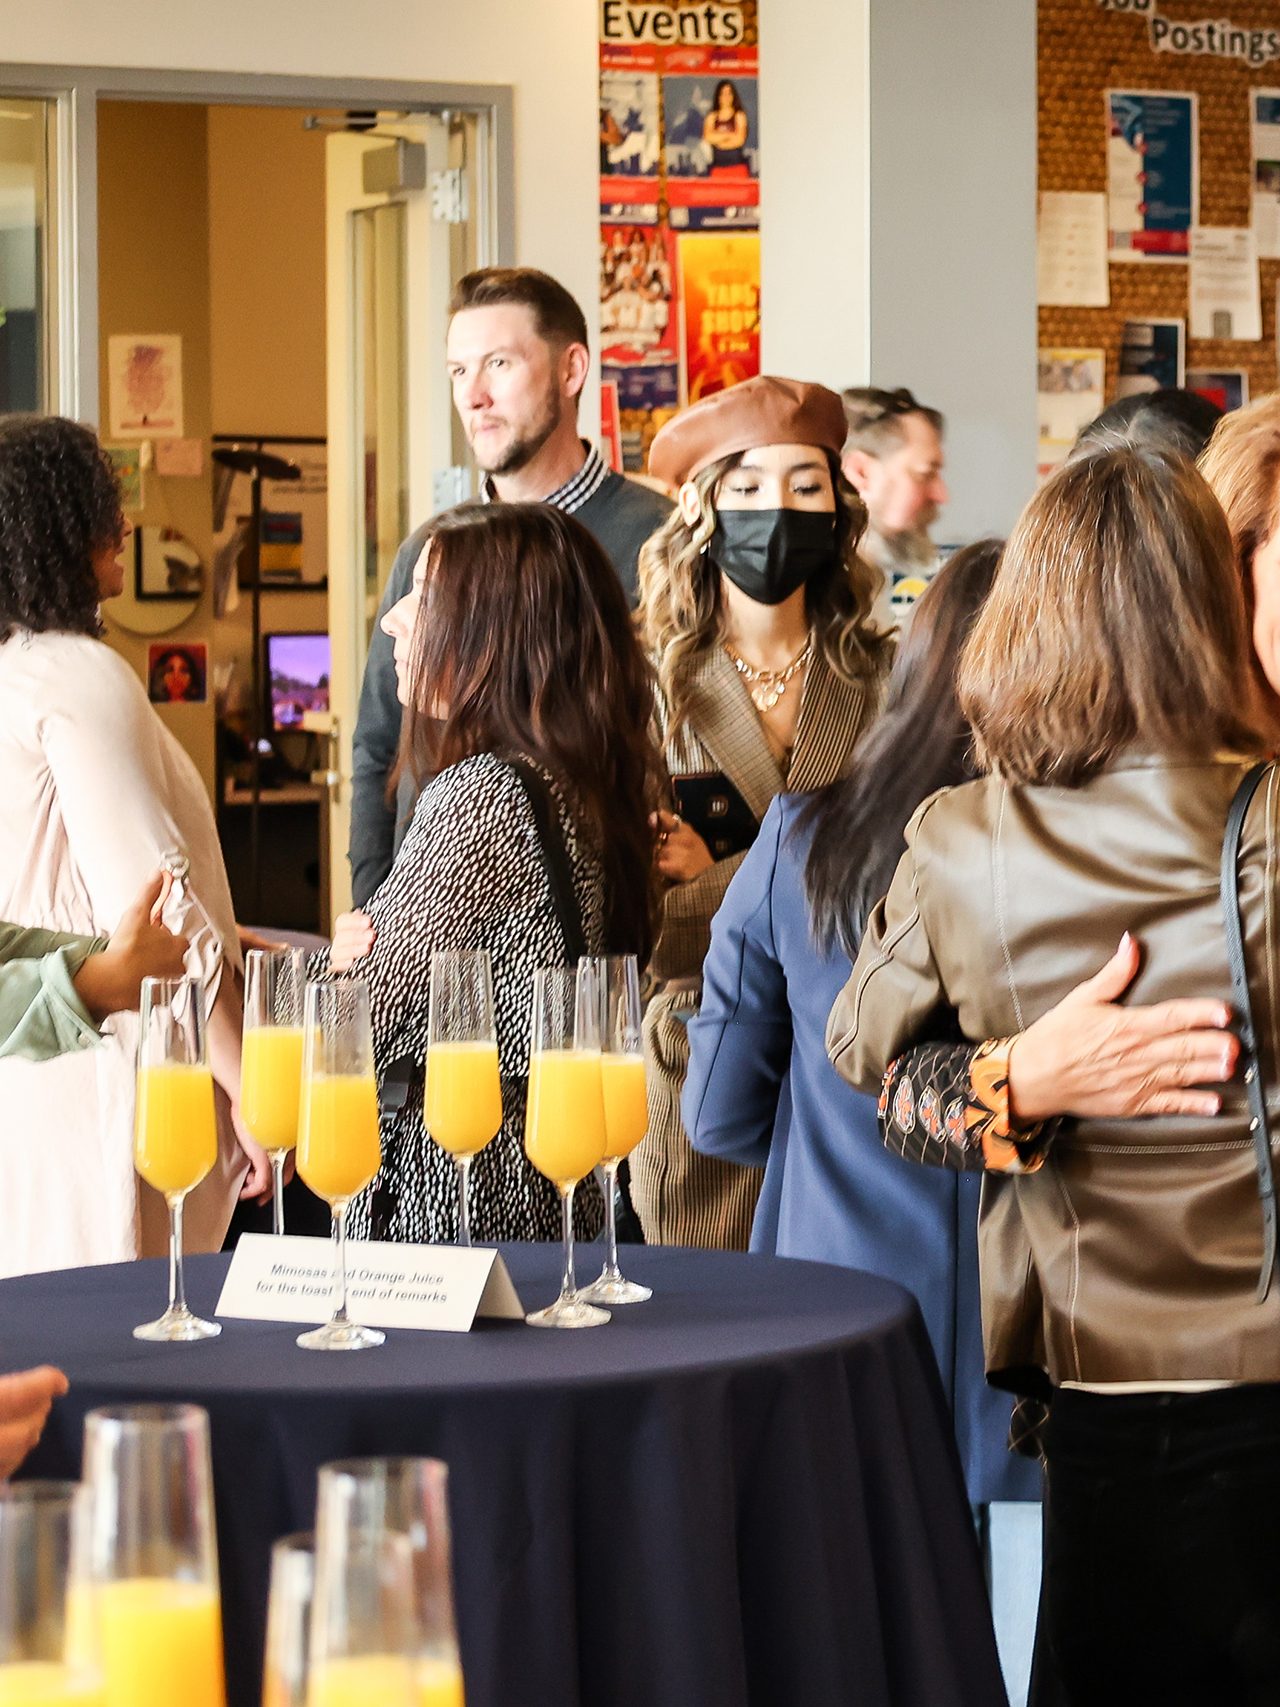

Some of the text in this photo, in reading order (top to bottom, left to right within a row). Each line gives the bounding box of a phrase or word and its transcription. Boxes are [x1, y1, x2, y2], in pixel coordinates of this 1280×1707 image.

[603, 1, 738, 40] Events
[1152, 18, 1280, 62] Postings
[271, 1264, 444, 1285] Mimosas ad Orange Juice
[256, 1280, 274, 1294] for
[277, 1282, 298, 1295] the
[301, 1284, 334, 1297] toast
[379, 1288, 393, 1301] of
[394, 1290, 448, 1304] remarks
